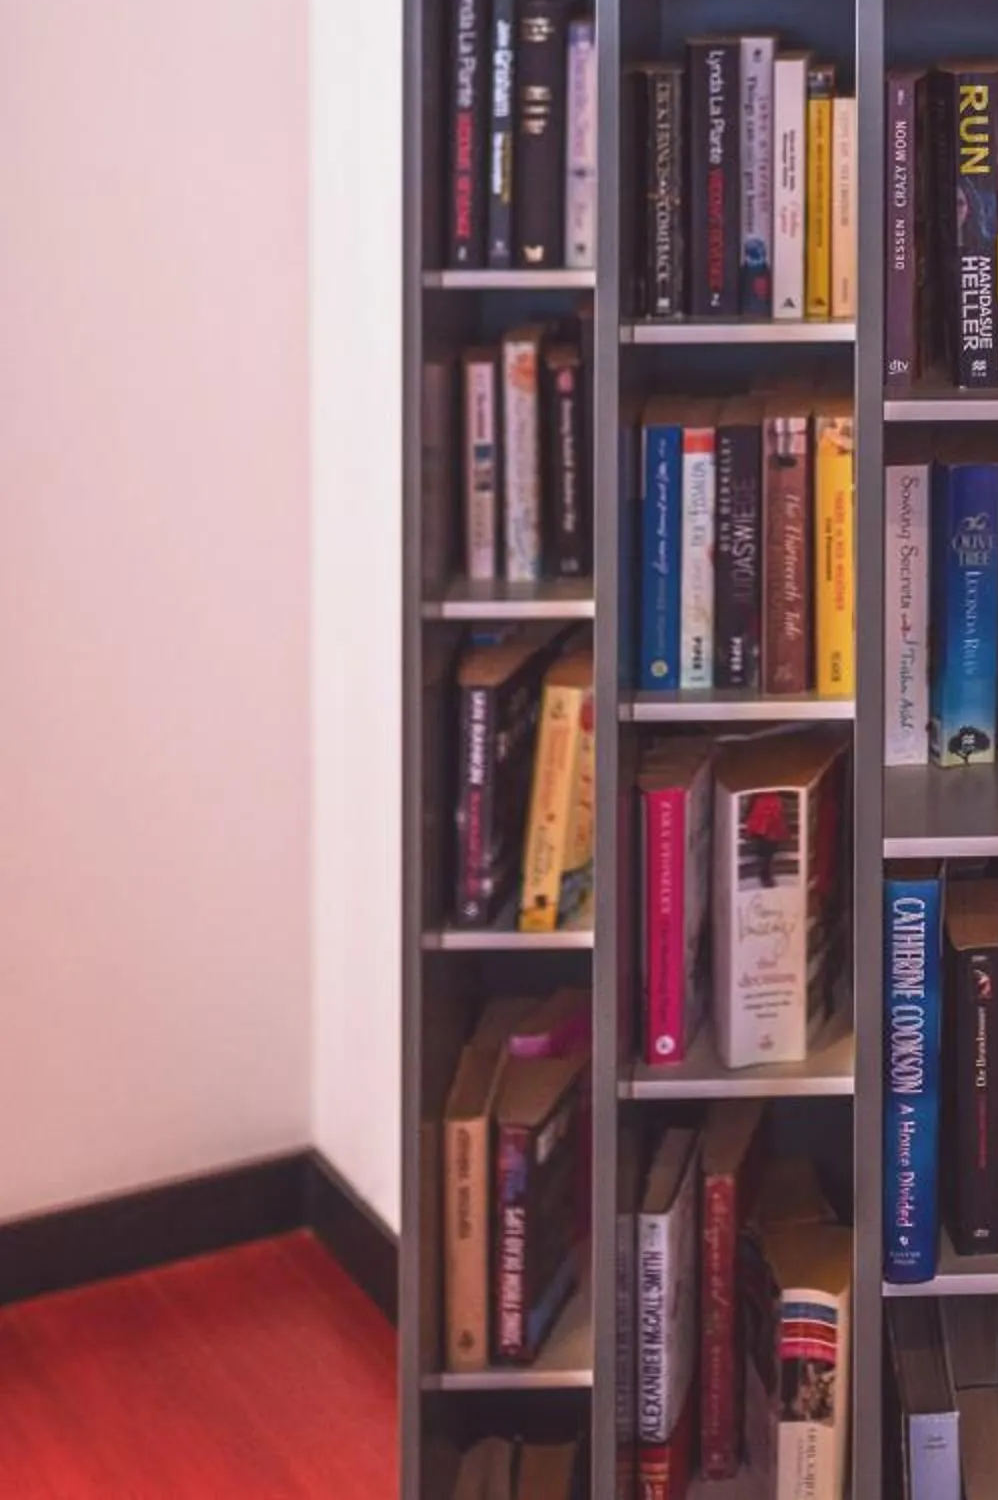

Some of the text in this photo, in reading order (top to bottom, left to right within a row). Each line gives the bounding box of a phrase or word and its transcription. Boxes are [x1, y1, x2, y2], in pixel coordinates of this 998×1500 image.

[459, 32, 476, 54] La
[706, 50, 724, 92] Lynda
[457, 57, 476, 107] Plante
[709, 96, 724, 115] La
[709, 118, 725, 163] Plante
[744, 76, 756, 233] Things can get better
[959, 84, 990, 175] RUN
[893, 121, 906, 270] DESSEN CRAZY MOON
[656, 201, 670, 282] COMEBACK
[961, 256, 979, 351] HELLER
[979, 256, 993, 349] MANDASUE
[784, 494, 802, 640] The Thirteenth Tale
[897, 476, 918, 609] Sowing Secrets
[963, 571, 979, 635] LUCINDA
[692, 636, 703, 671] PIPER
[730, 636, 743, 671] PIPER
[900, 649, 915, 694] Trisha
[890, 897, 926, 1227] CATHERINE COOKSON A House Divided
[644, 1251, 665, 1289] SMITH
[644, 1347, 665, 1443] ALEXANDER
